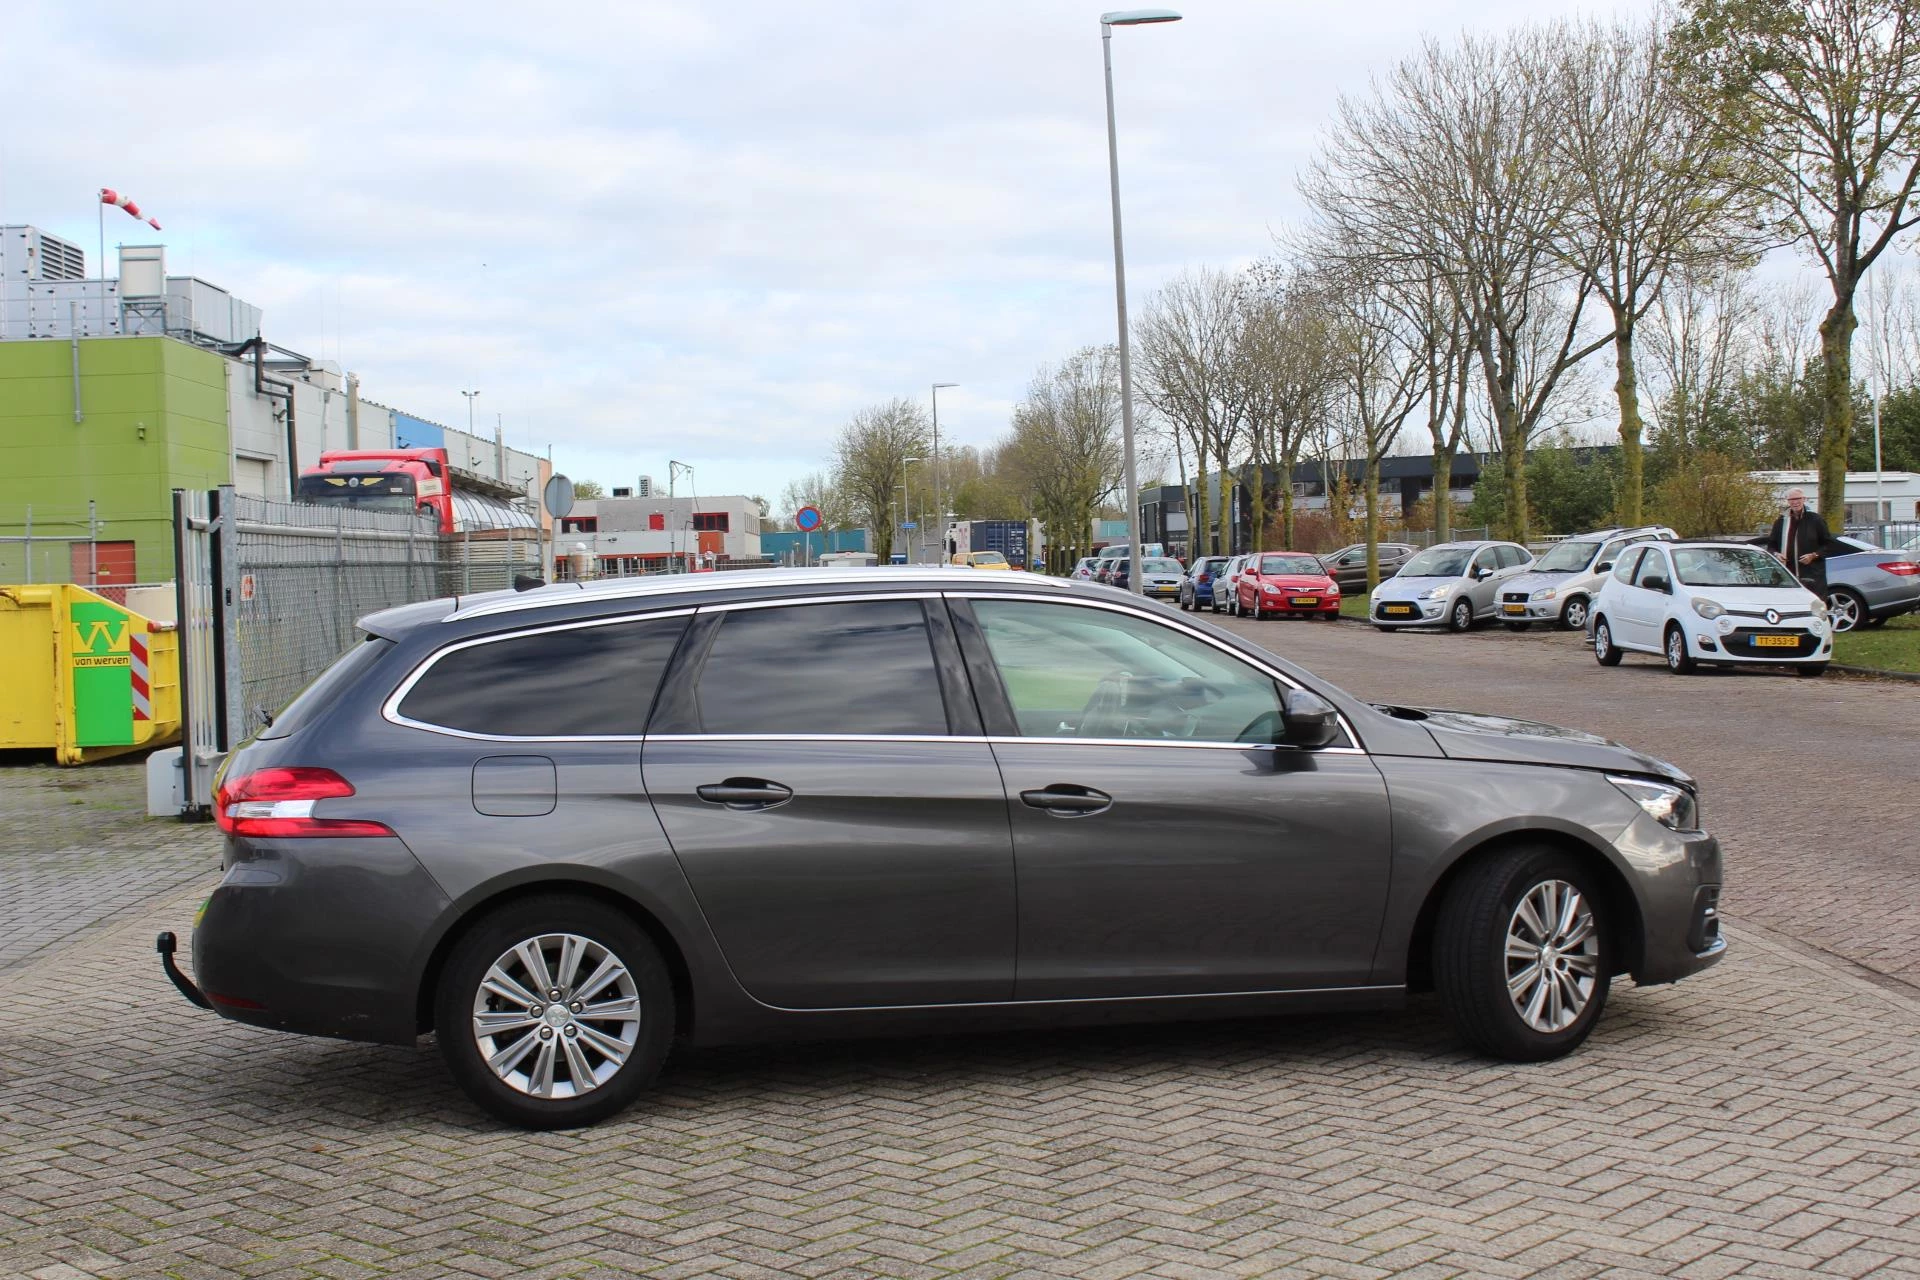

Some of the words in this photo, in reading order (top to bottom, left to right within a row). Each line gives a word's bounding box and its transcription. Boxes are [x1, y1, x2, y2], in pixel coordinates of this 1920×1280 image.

[1760, 637, 1795, 646] TT-353-S
[75, 658, 92, 666] van
[93, 657, 129, 665] werven
